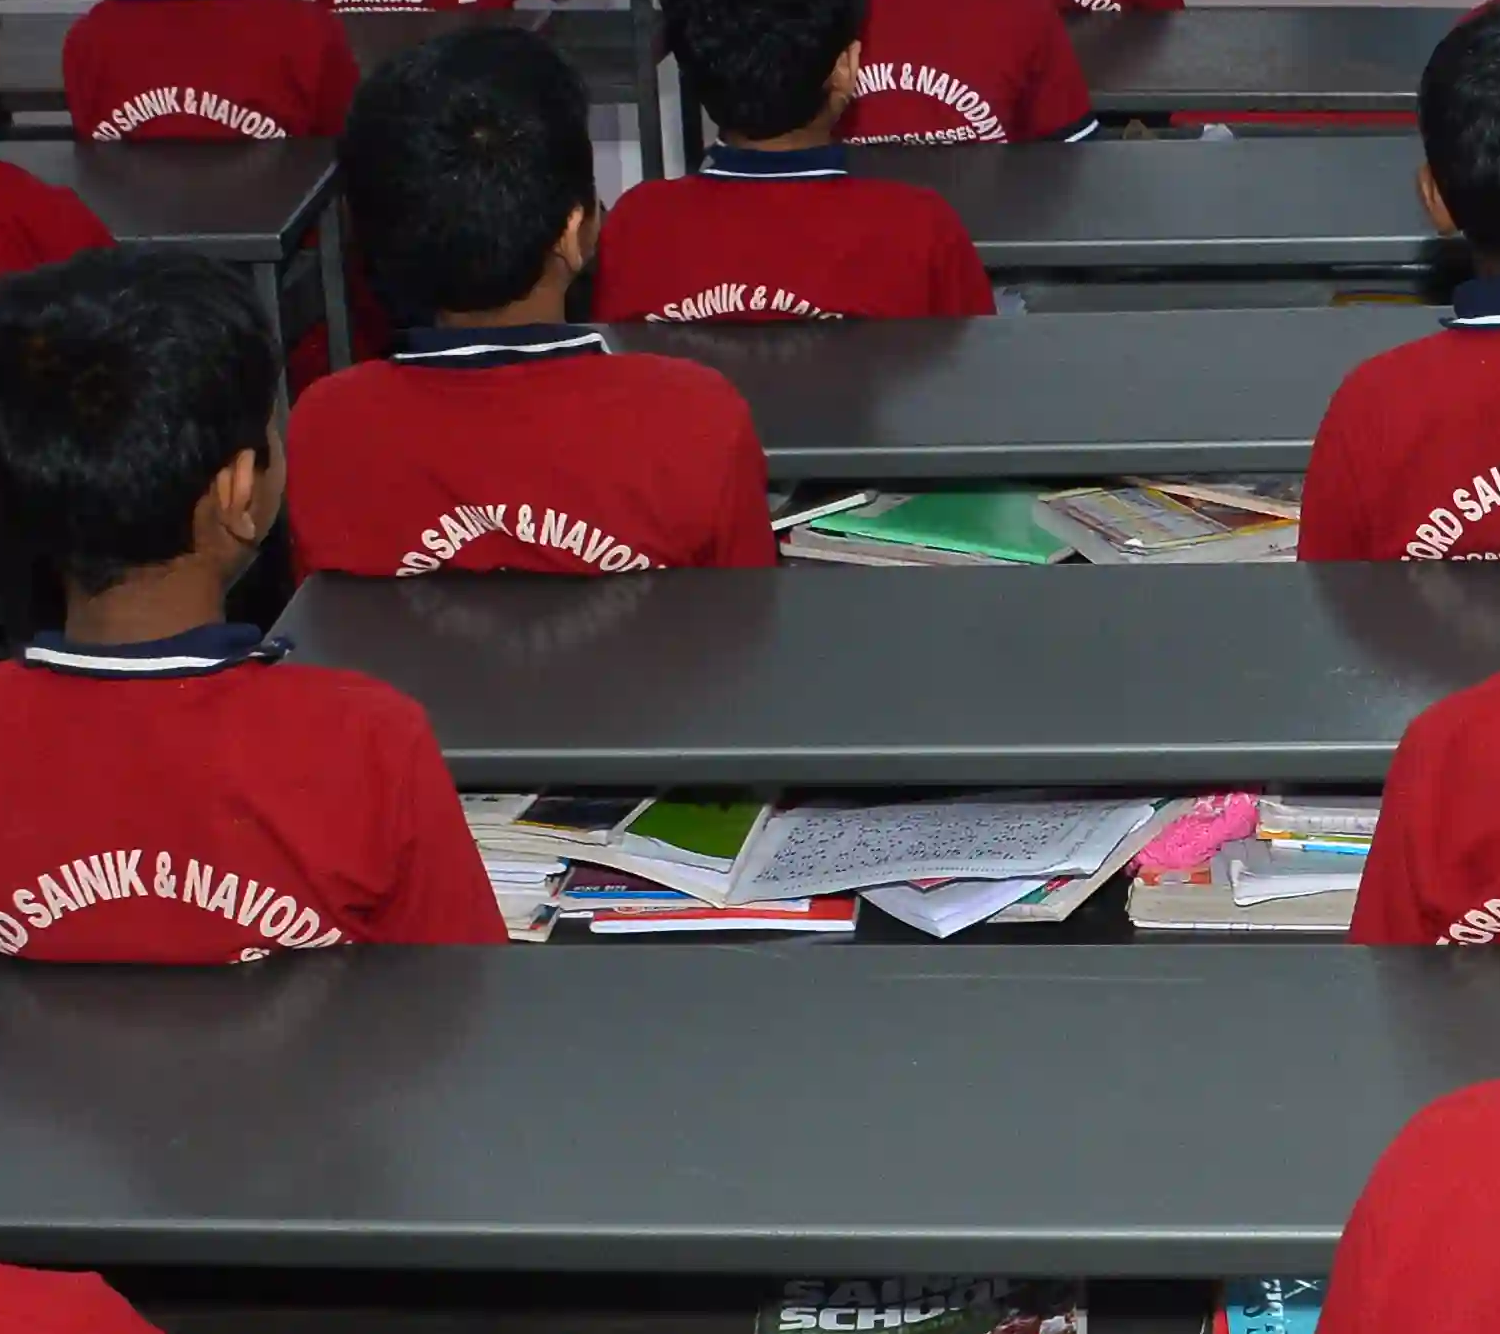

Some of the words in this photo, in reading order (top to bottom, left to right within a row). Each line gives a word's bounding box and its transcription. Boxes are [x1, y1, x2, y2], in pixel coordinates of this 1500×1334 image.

[112, 87, 180, 131] SAINIK
[184, 87, 198, 114] &
[200, 91, 286, 139] NAVOD
[900, 63, 914, 91] &
[917, 66, 1008, 144] NAVODAY
[663, 283, 747, 322] SAINIK
[750, 285, 768, 311] &
[516, 504, 535, 544] &
[1401, 508, 1463, 561] ORD
[12, 849, 148, 929] SAINIK
[154, 851, 176, 899] &
